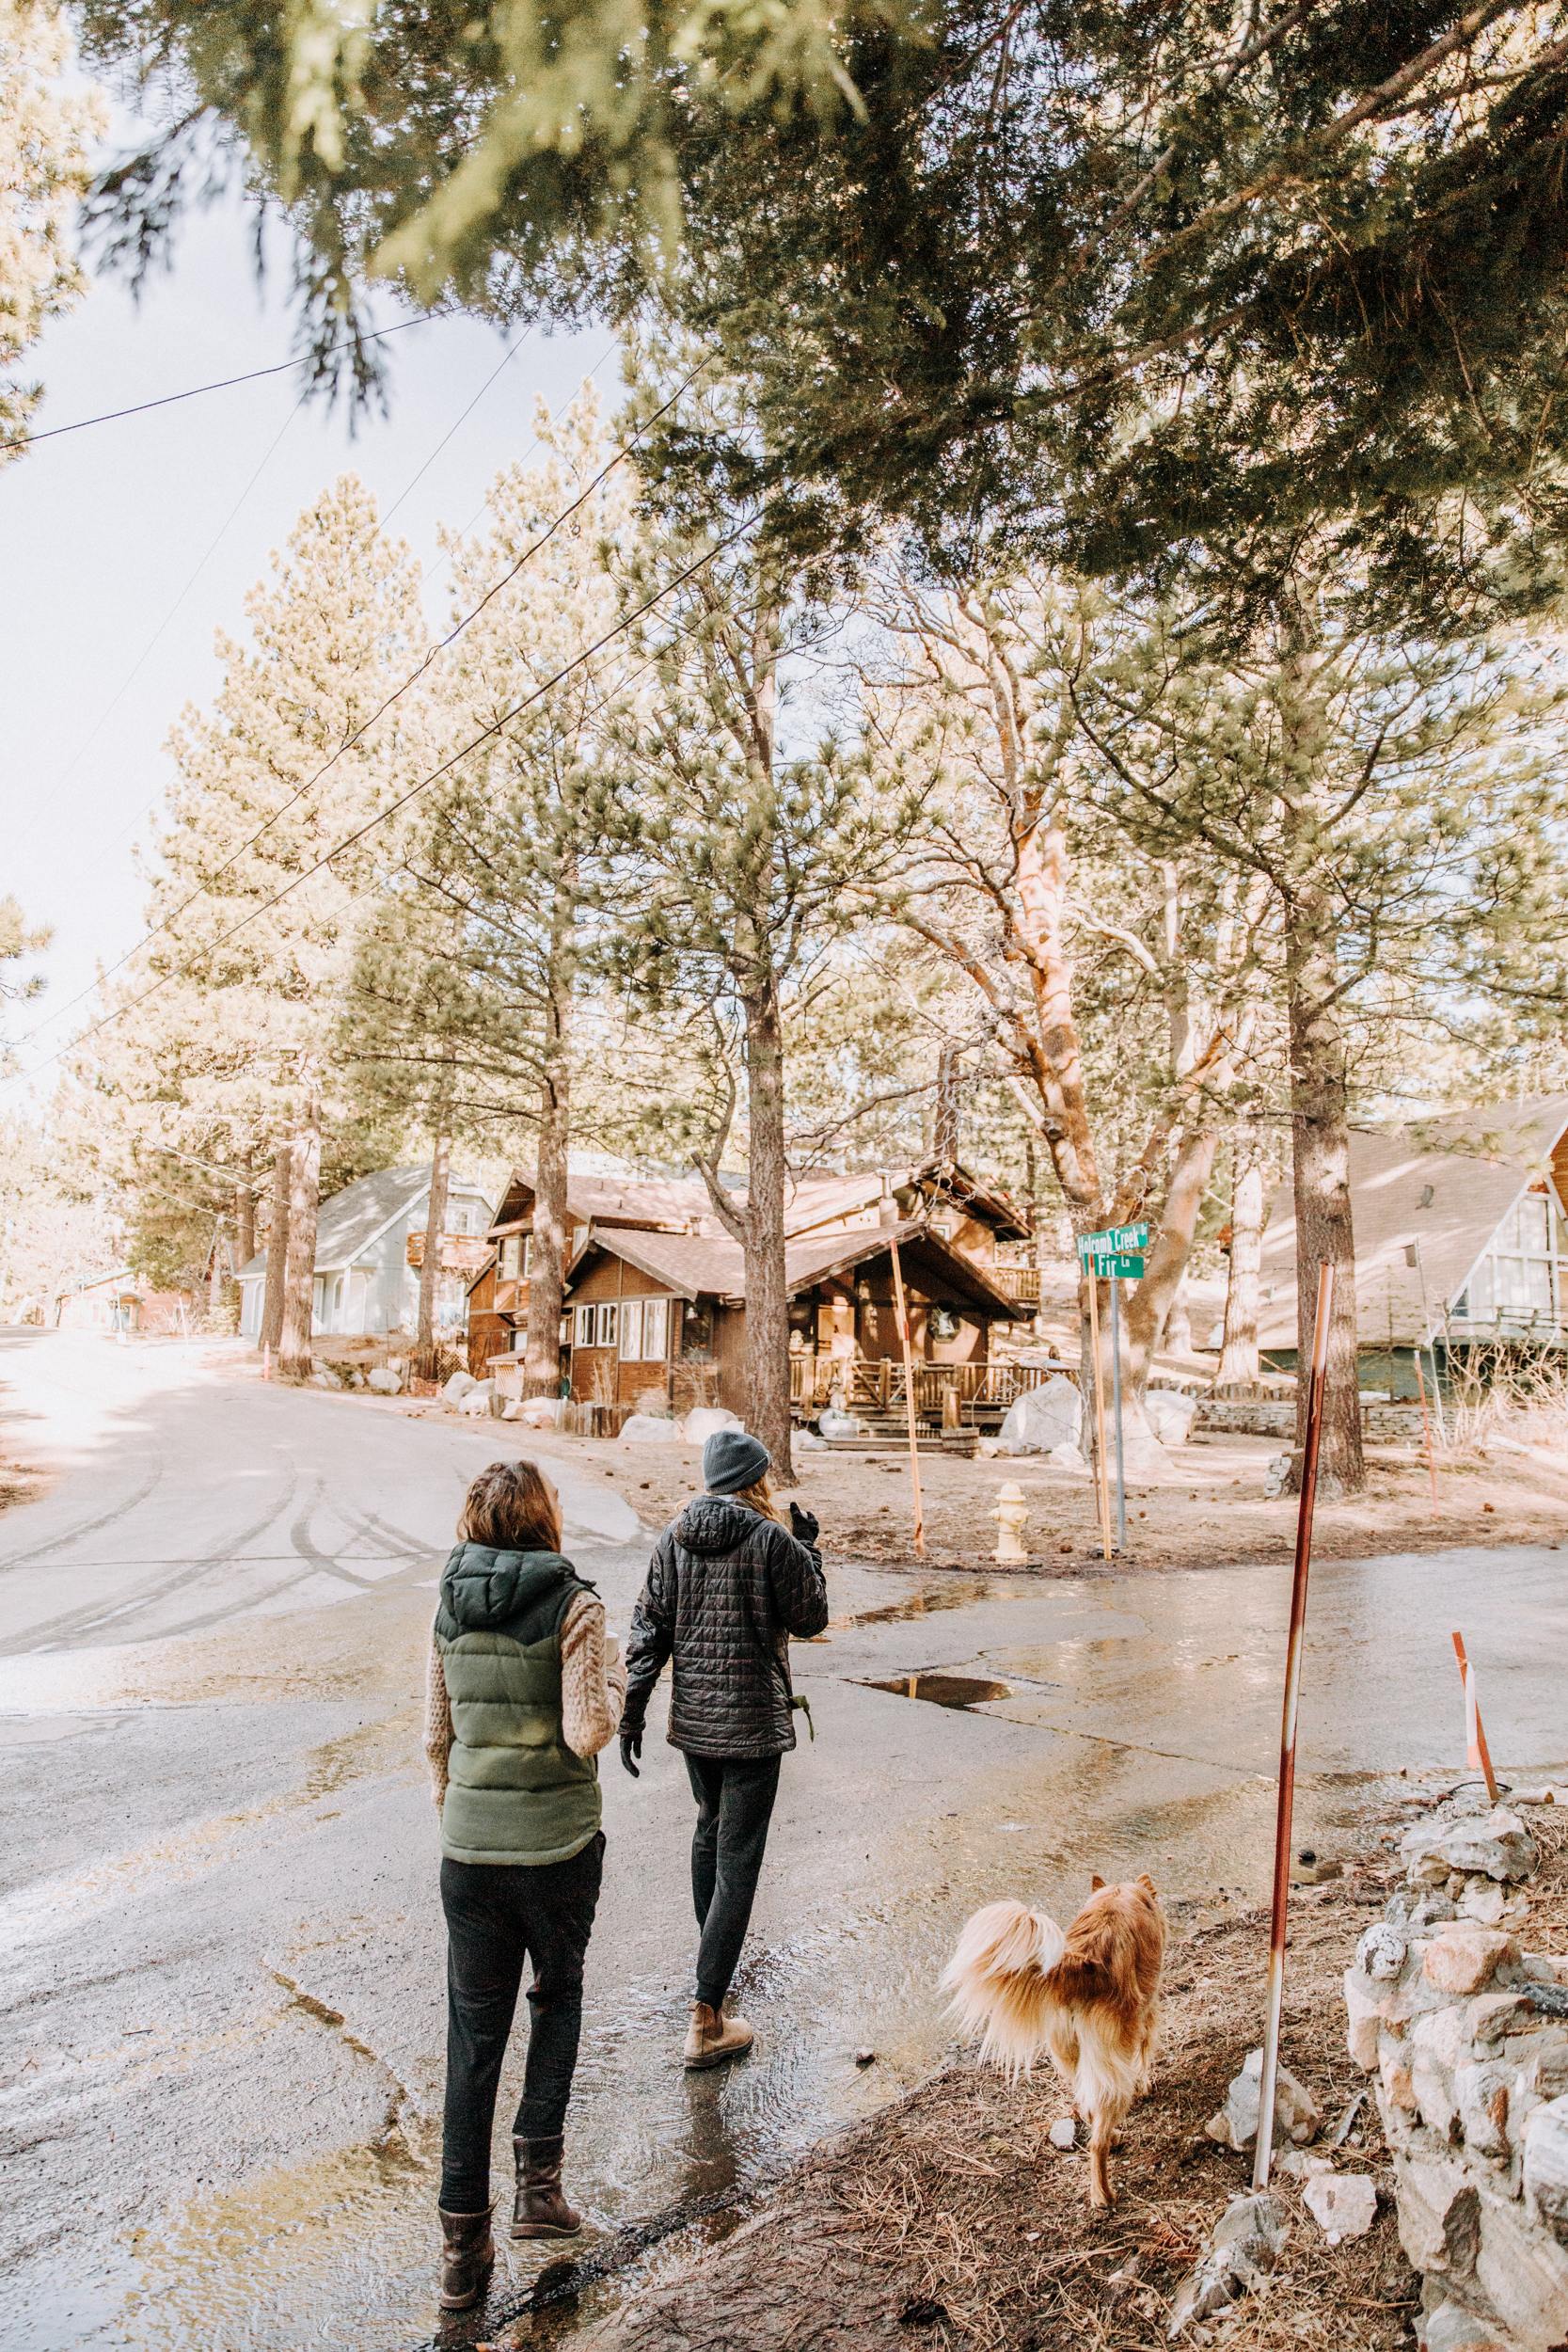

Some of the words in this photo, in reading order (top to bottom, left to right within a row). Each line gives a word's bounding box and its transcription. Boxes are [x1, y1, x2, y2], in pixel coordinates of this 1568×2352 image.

[1077, 1232, 1113, 1256] Holcomb
[1115, 1226, 1139, 1251] Creek
[1099, 1254, 1117, 1277] Fir
[1121, 1255, 1130, 1267] Ln
